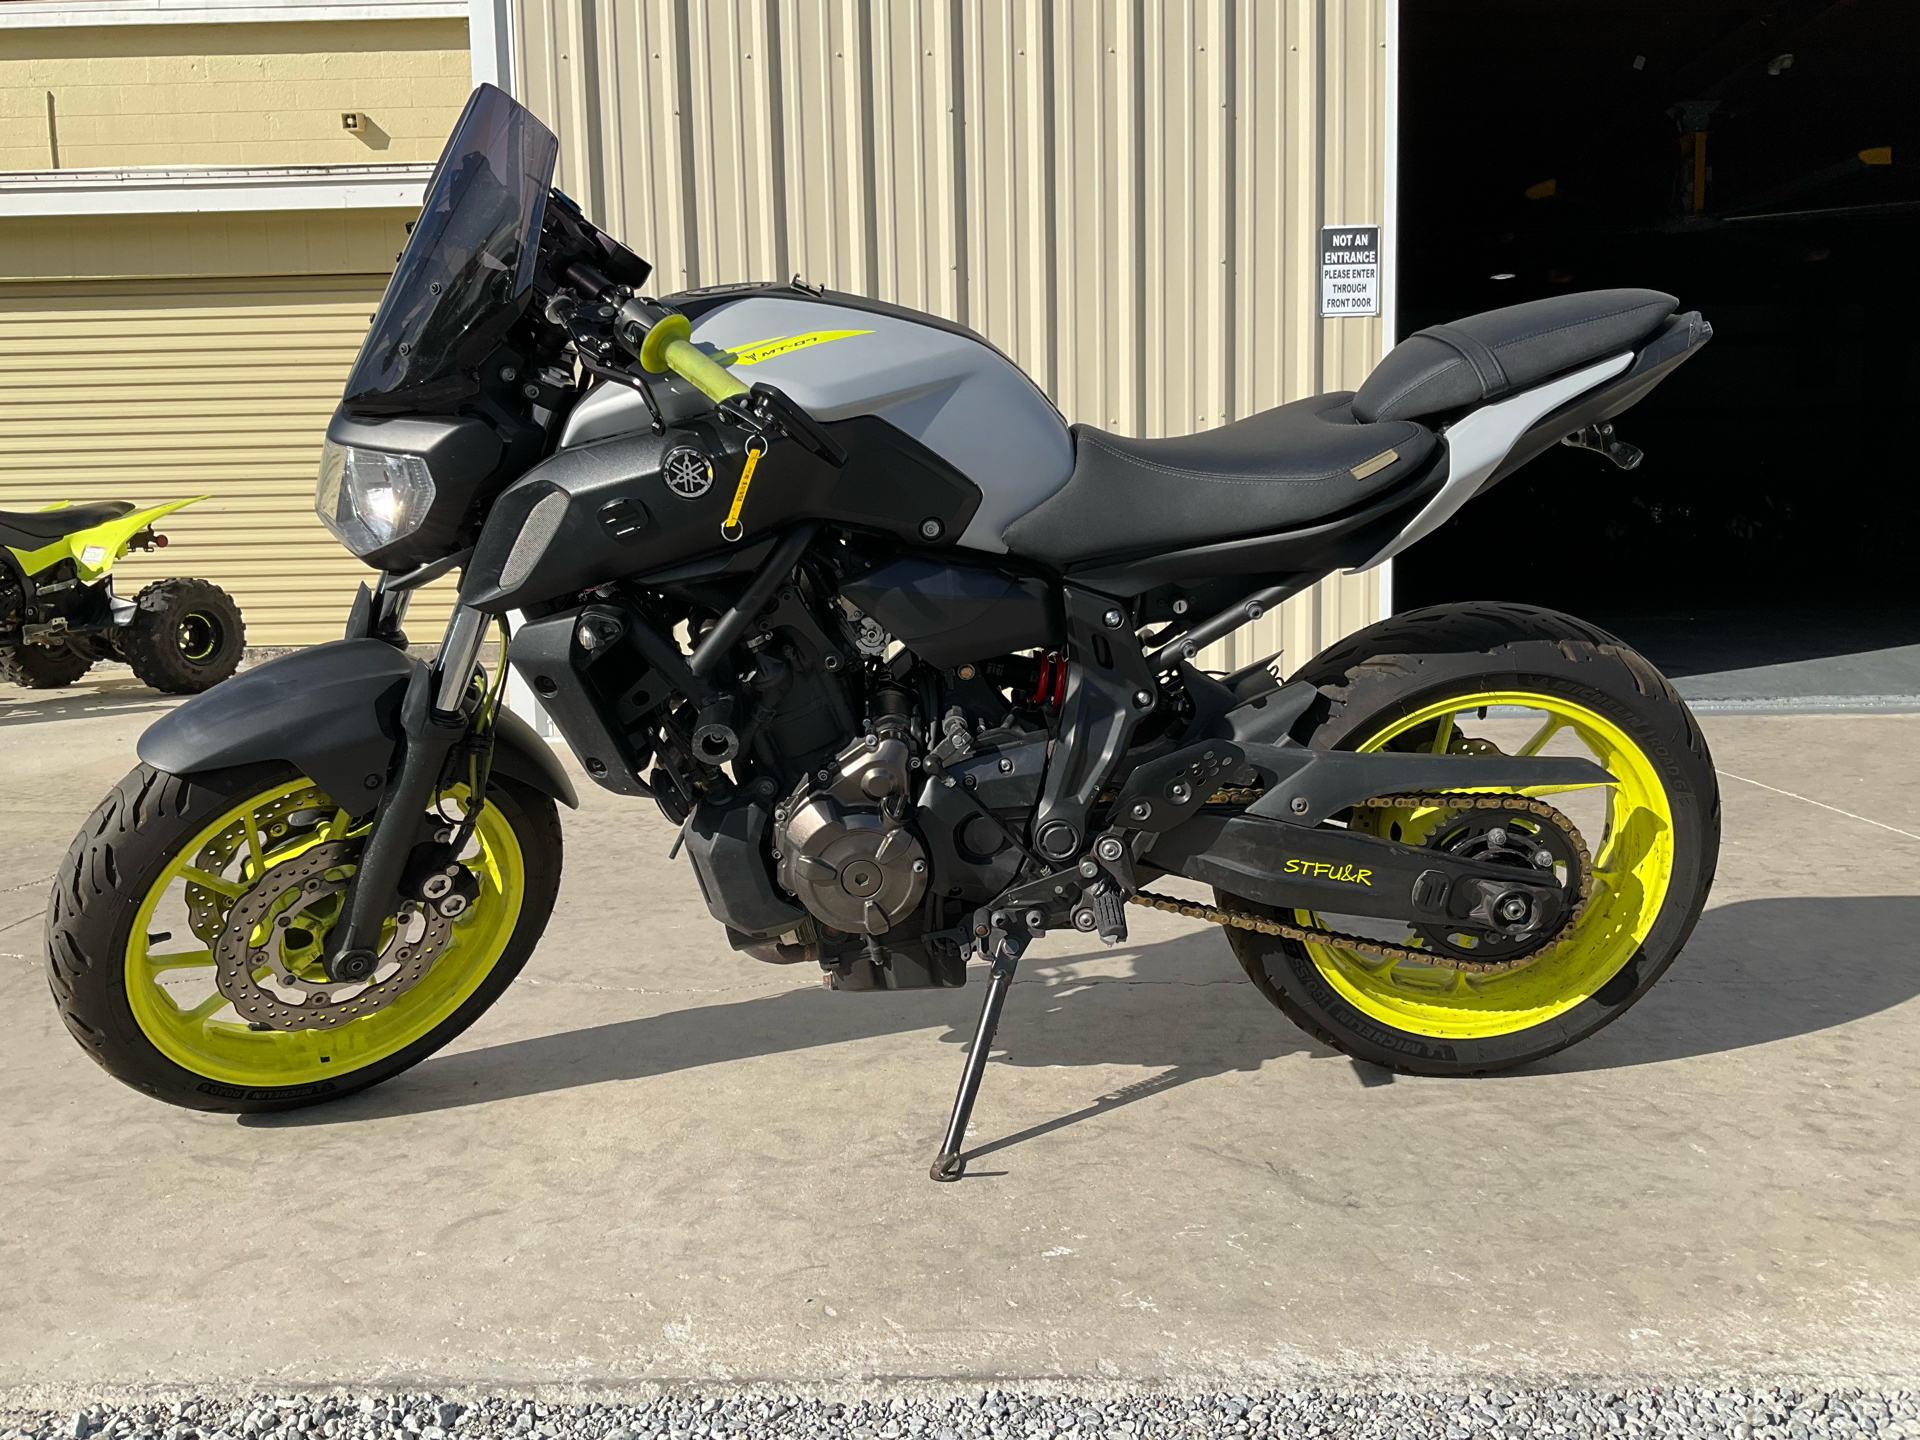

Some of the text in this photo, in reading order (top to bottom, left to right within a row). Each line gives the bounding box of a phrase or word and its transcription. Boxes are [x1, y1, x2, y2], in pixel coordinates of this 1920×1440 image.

[1332, 234, 1368, 246] NOT AN
[1325, 251, 1375, 263] ENTRANCE
[1324, 269, 1375, 279] PLEASE ENTER
[1333, 284, 1367, 293] THROUGH
[1327, 298, 1371, 308] FRONT DOOR
[762, 337, 817, 357] MT-07
[1551, 681, 1649, 730] MICHELIN
[1649, 737, 1681, 779] ROAD
[1284, 859, 1372, 886] STFU&R
[1335, 1010, 1423, 1054] MICHELIN
[212, 1085, 241, 1098] ROAD
[252, 1086, 313, 1099] MICHELIN
